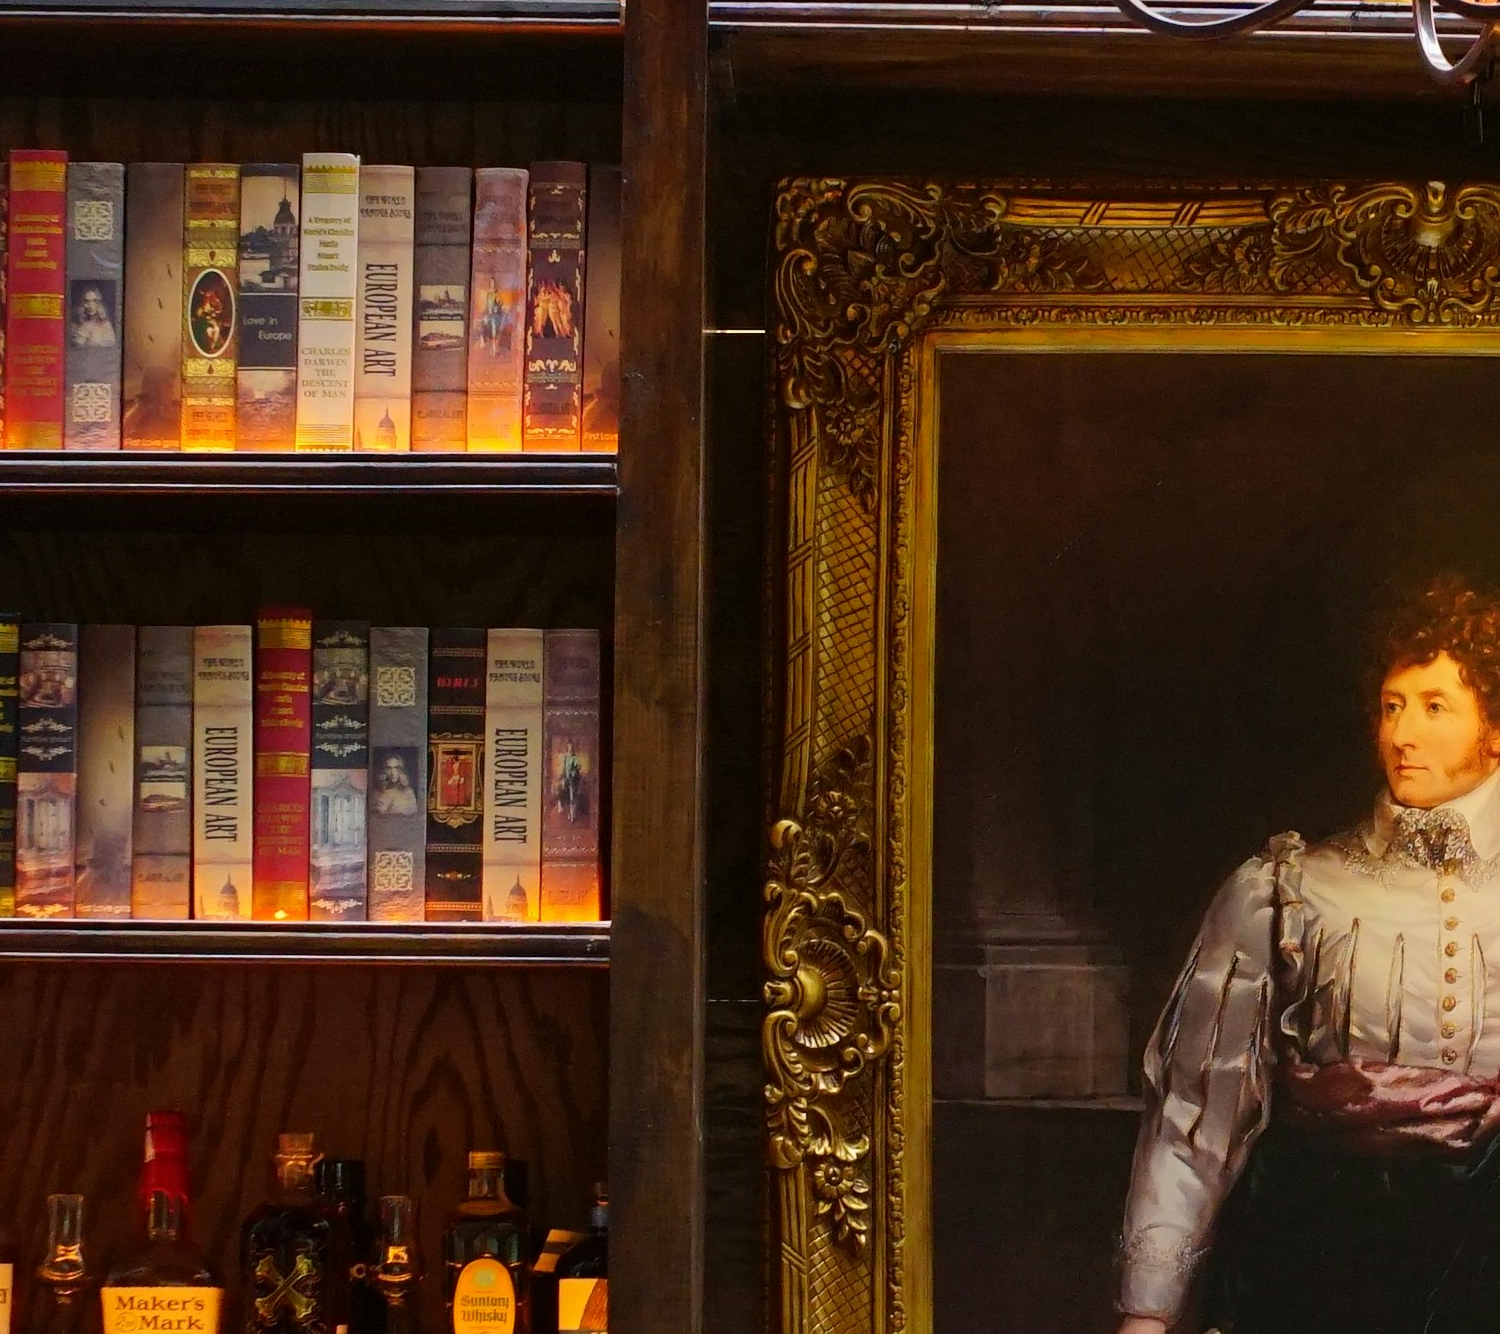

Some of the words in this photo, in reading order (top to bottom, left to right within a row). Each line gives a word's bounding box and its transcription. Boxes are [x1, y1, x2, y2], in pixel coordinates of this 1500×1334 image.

[363, 263, 398, 342] EUROPEAN
[363, 348, 397, 377] ART
[204, 726, 238, 806] EUROPEAN
[494, 728, 528, 808] EUROPEAN
[204, 813, 237, 842] ART
[493, 814, 528, 843] ART
[114, 1296, 205, 1312] Maker's
[460, 1294, 509, 1312] Suntory
[461, 1309, 508, 1325] Whisky
[139, 1315, 204, 1332] Mark
